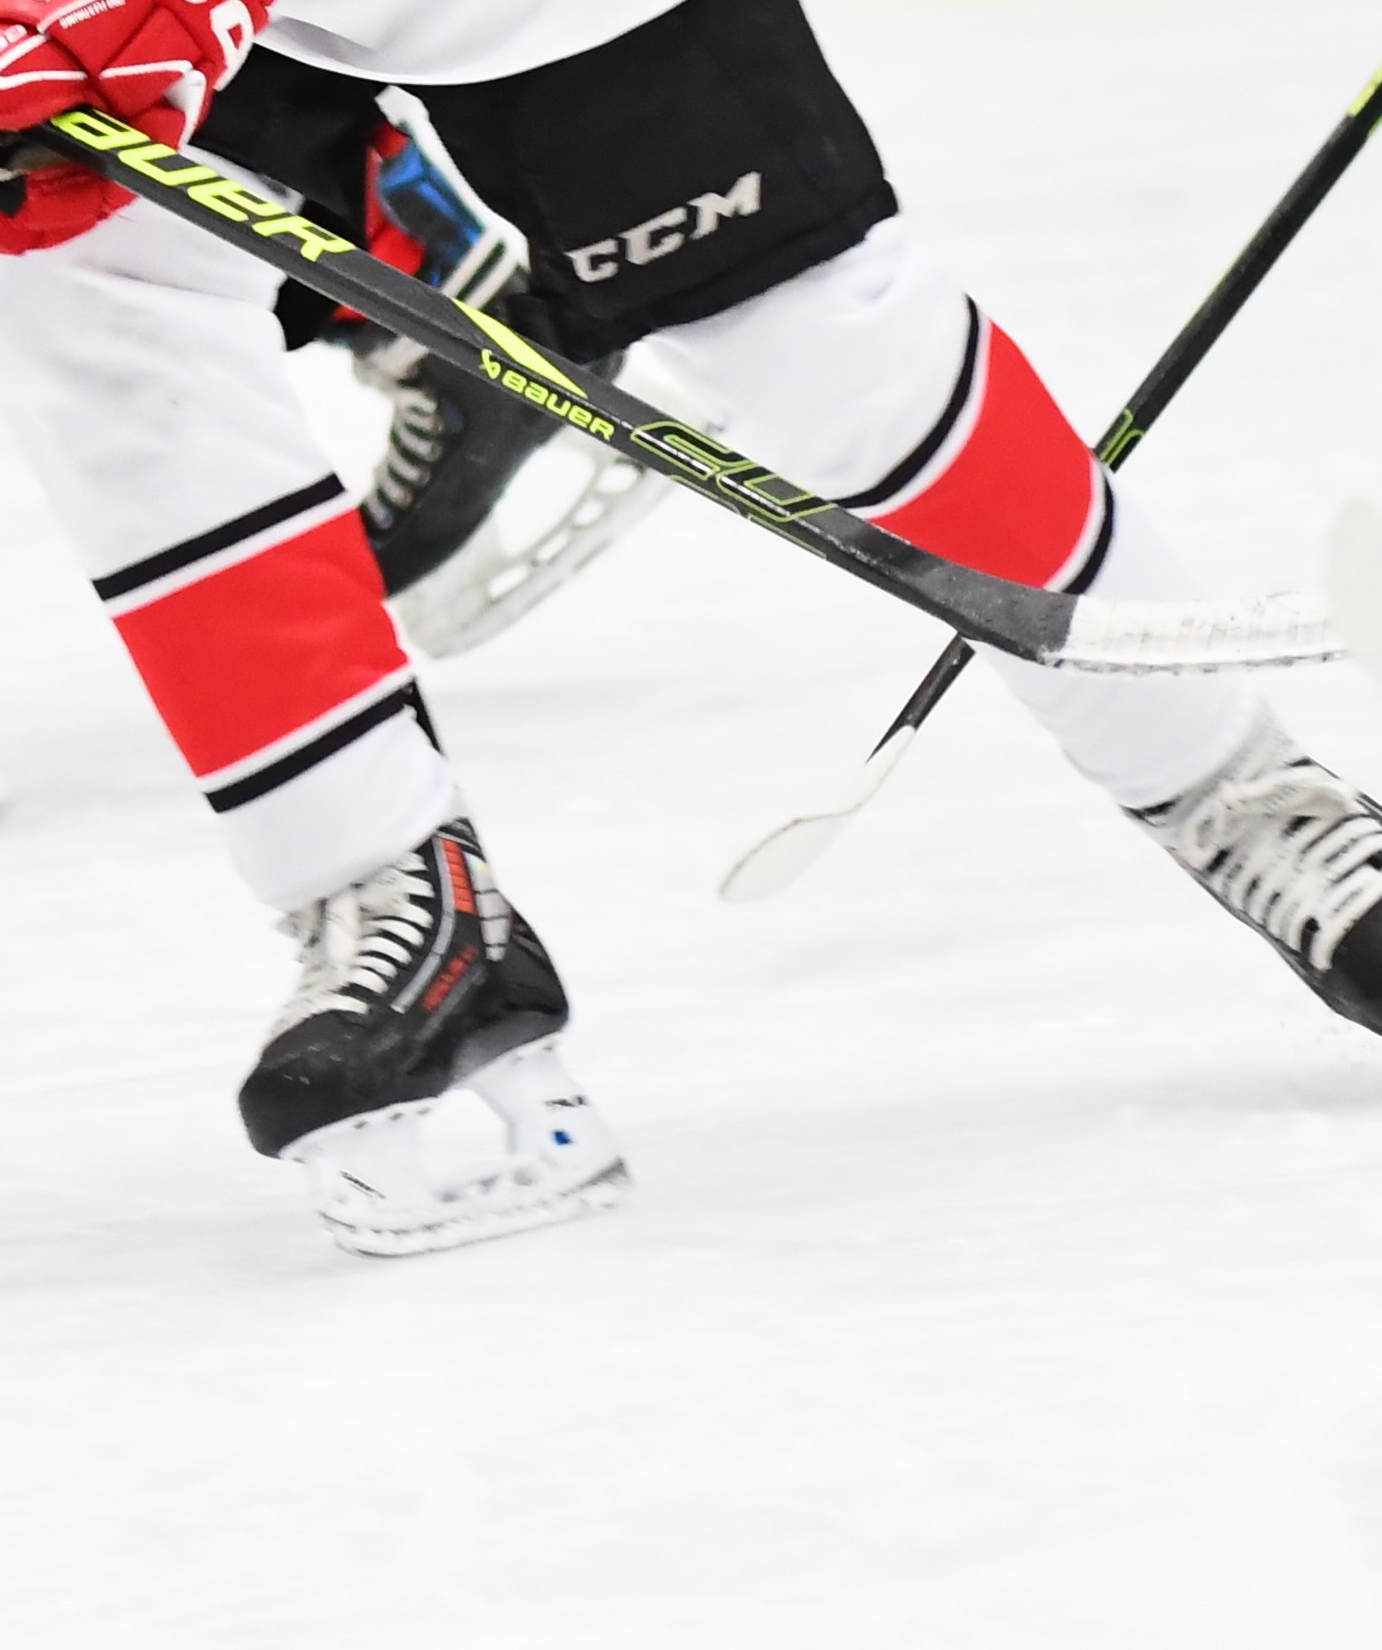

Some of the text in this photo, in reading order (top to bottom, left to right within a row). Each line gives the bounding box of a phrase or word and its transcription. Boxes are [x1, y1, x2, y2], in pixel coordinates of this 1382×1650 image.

[49, 109, 357, 264] AUER
[564, 170, 764, 284] CCM
[501, 372, 616, 442] BAUER
